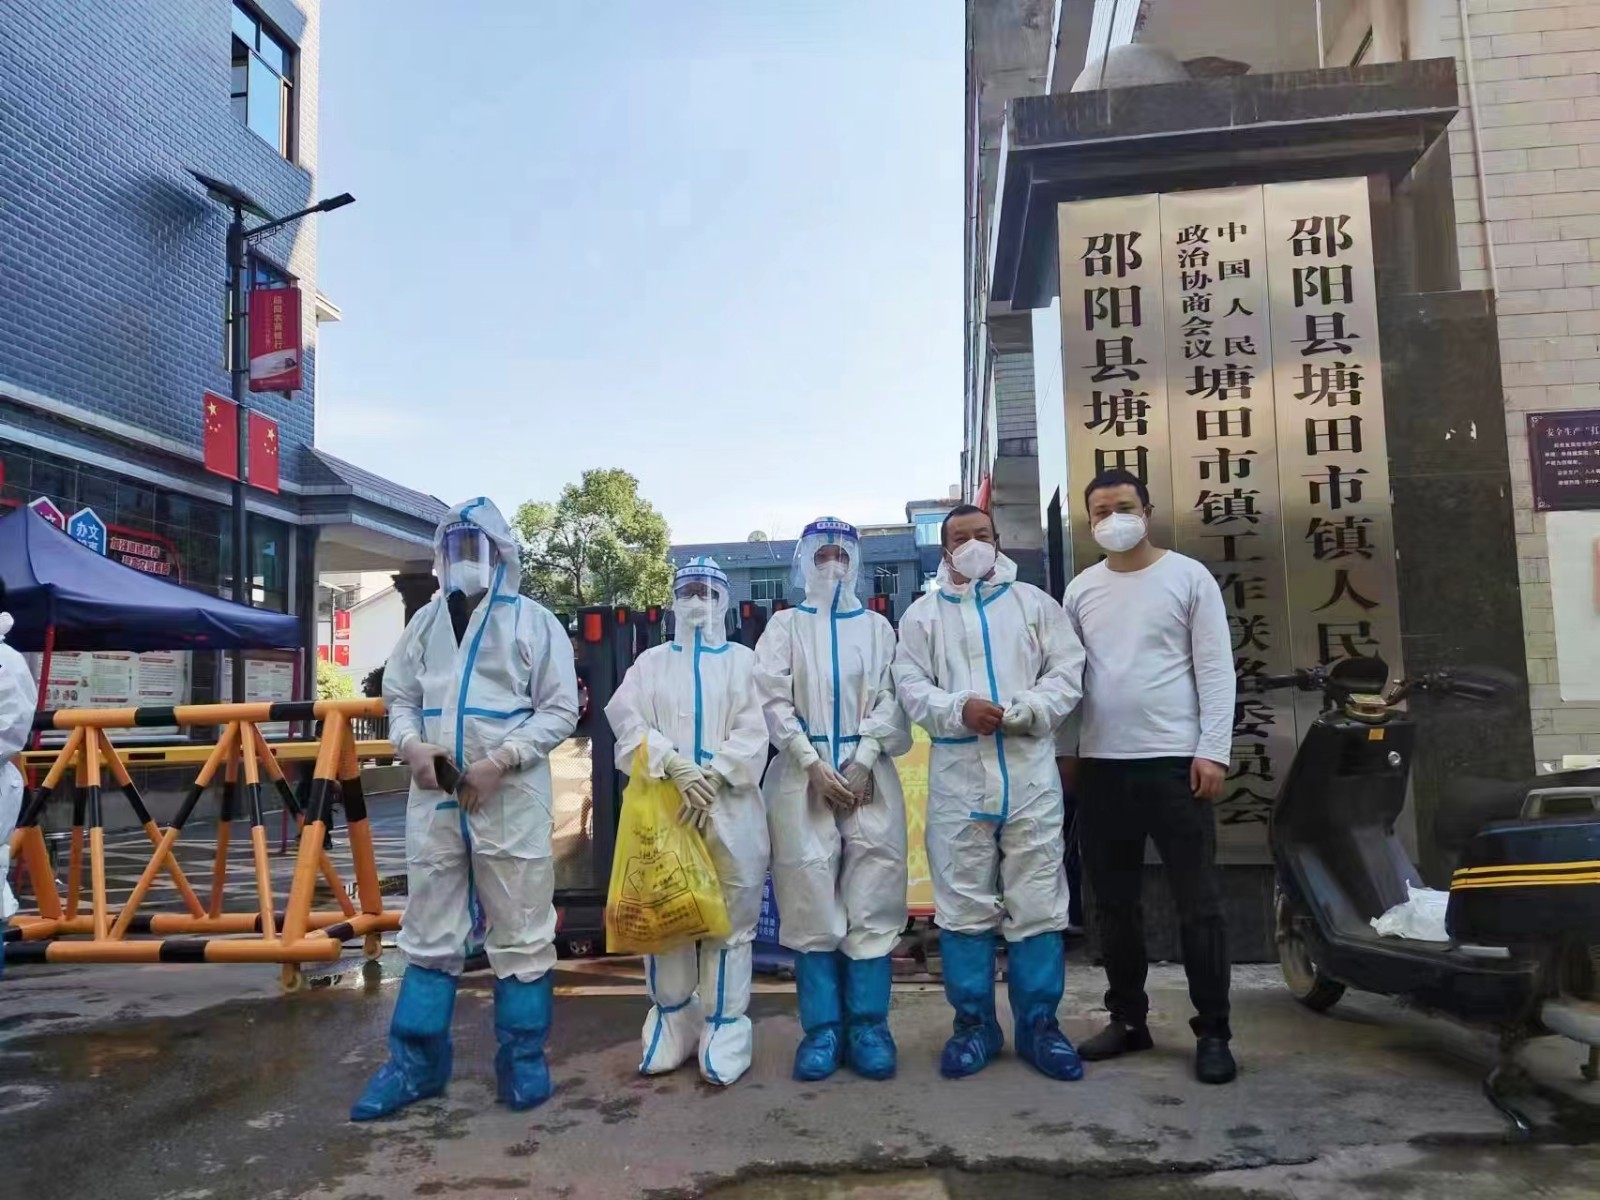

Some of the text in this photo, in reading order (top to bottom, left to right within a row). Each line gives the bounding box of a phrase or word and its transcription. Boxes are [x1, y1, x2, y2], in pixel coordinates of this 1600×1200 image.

[1176, 223, 1215, 360] 政治协商会议
[1217, 221, 1257, 357] 中国人民
[76, 521, 99, 541] 办文
